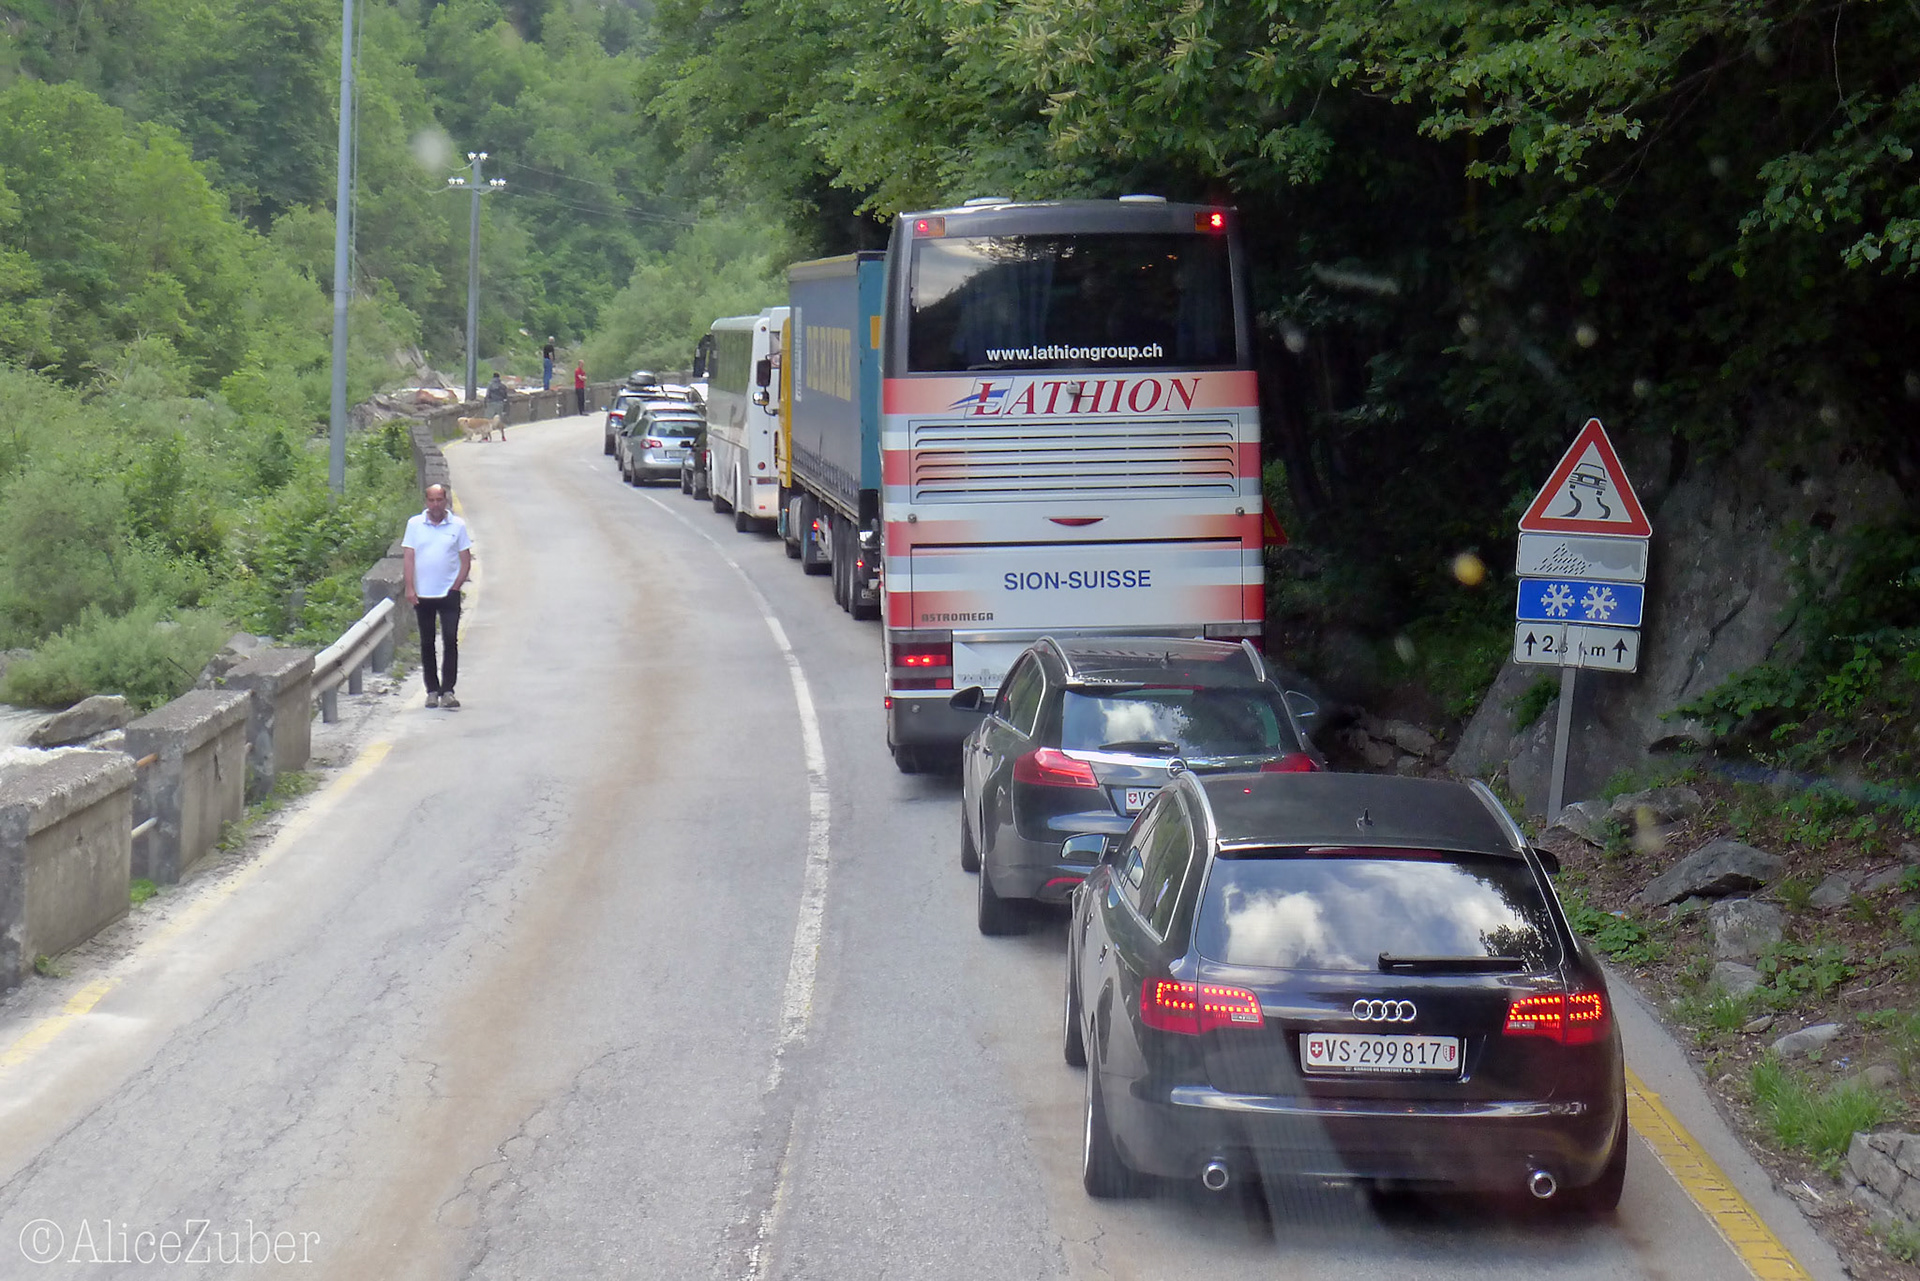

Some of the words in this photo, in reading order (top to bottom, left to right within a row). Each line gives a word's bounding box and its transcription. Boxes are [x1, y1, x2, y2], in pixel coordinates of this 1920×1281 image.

[986, 343, 1163, 361] www.lathiongroup.ch
[972, 378, 1202, 415] LATHION
[1004, 570, 1152, 590] SION-SUISSE
[921, 612, 994, 622] ASTROMEGA
